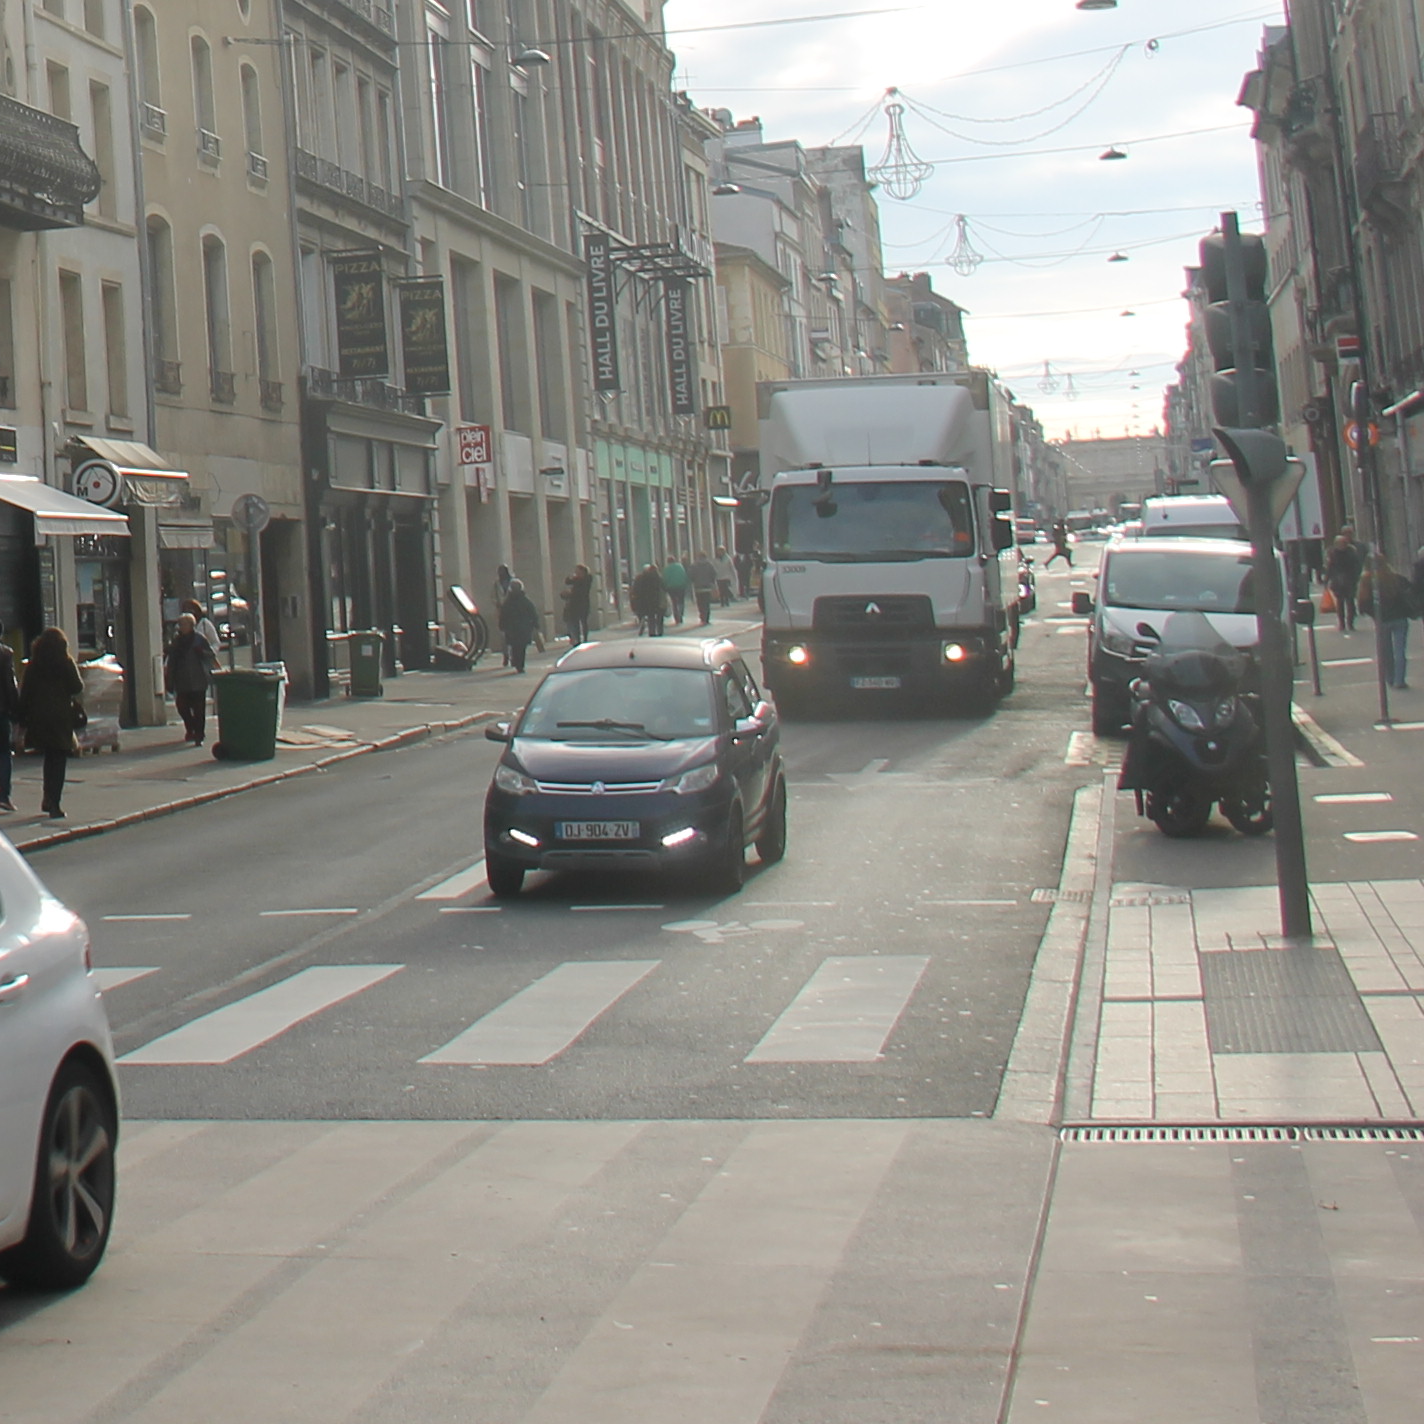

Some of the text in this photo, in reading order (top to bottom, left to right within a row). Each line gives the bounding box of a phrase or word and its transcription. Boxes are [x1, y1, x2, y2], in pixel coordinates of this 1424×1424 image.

[334, 261, 381, 275] PIZZA
[400, 289, 443, 301] PIZZA
[589, 243, 614, 380] HALL DU LIVRE
[668, 288, 689, 405] HALL DU LIVRE
[460, 428, 486, 447] plein
[461, 442, 487, 464] ciel
[77, 486, 89, 497] M
[564, 823, 631, 839] DJ-904-ZV
